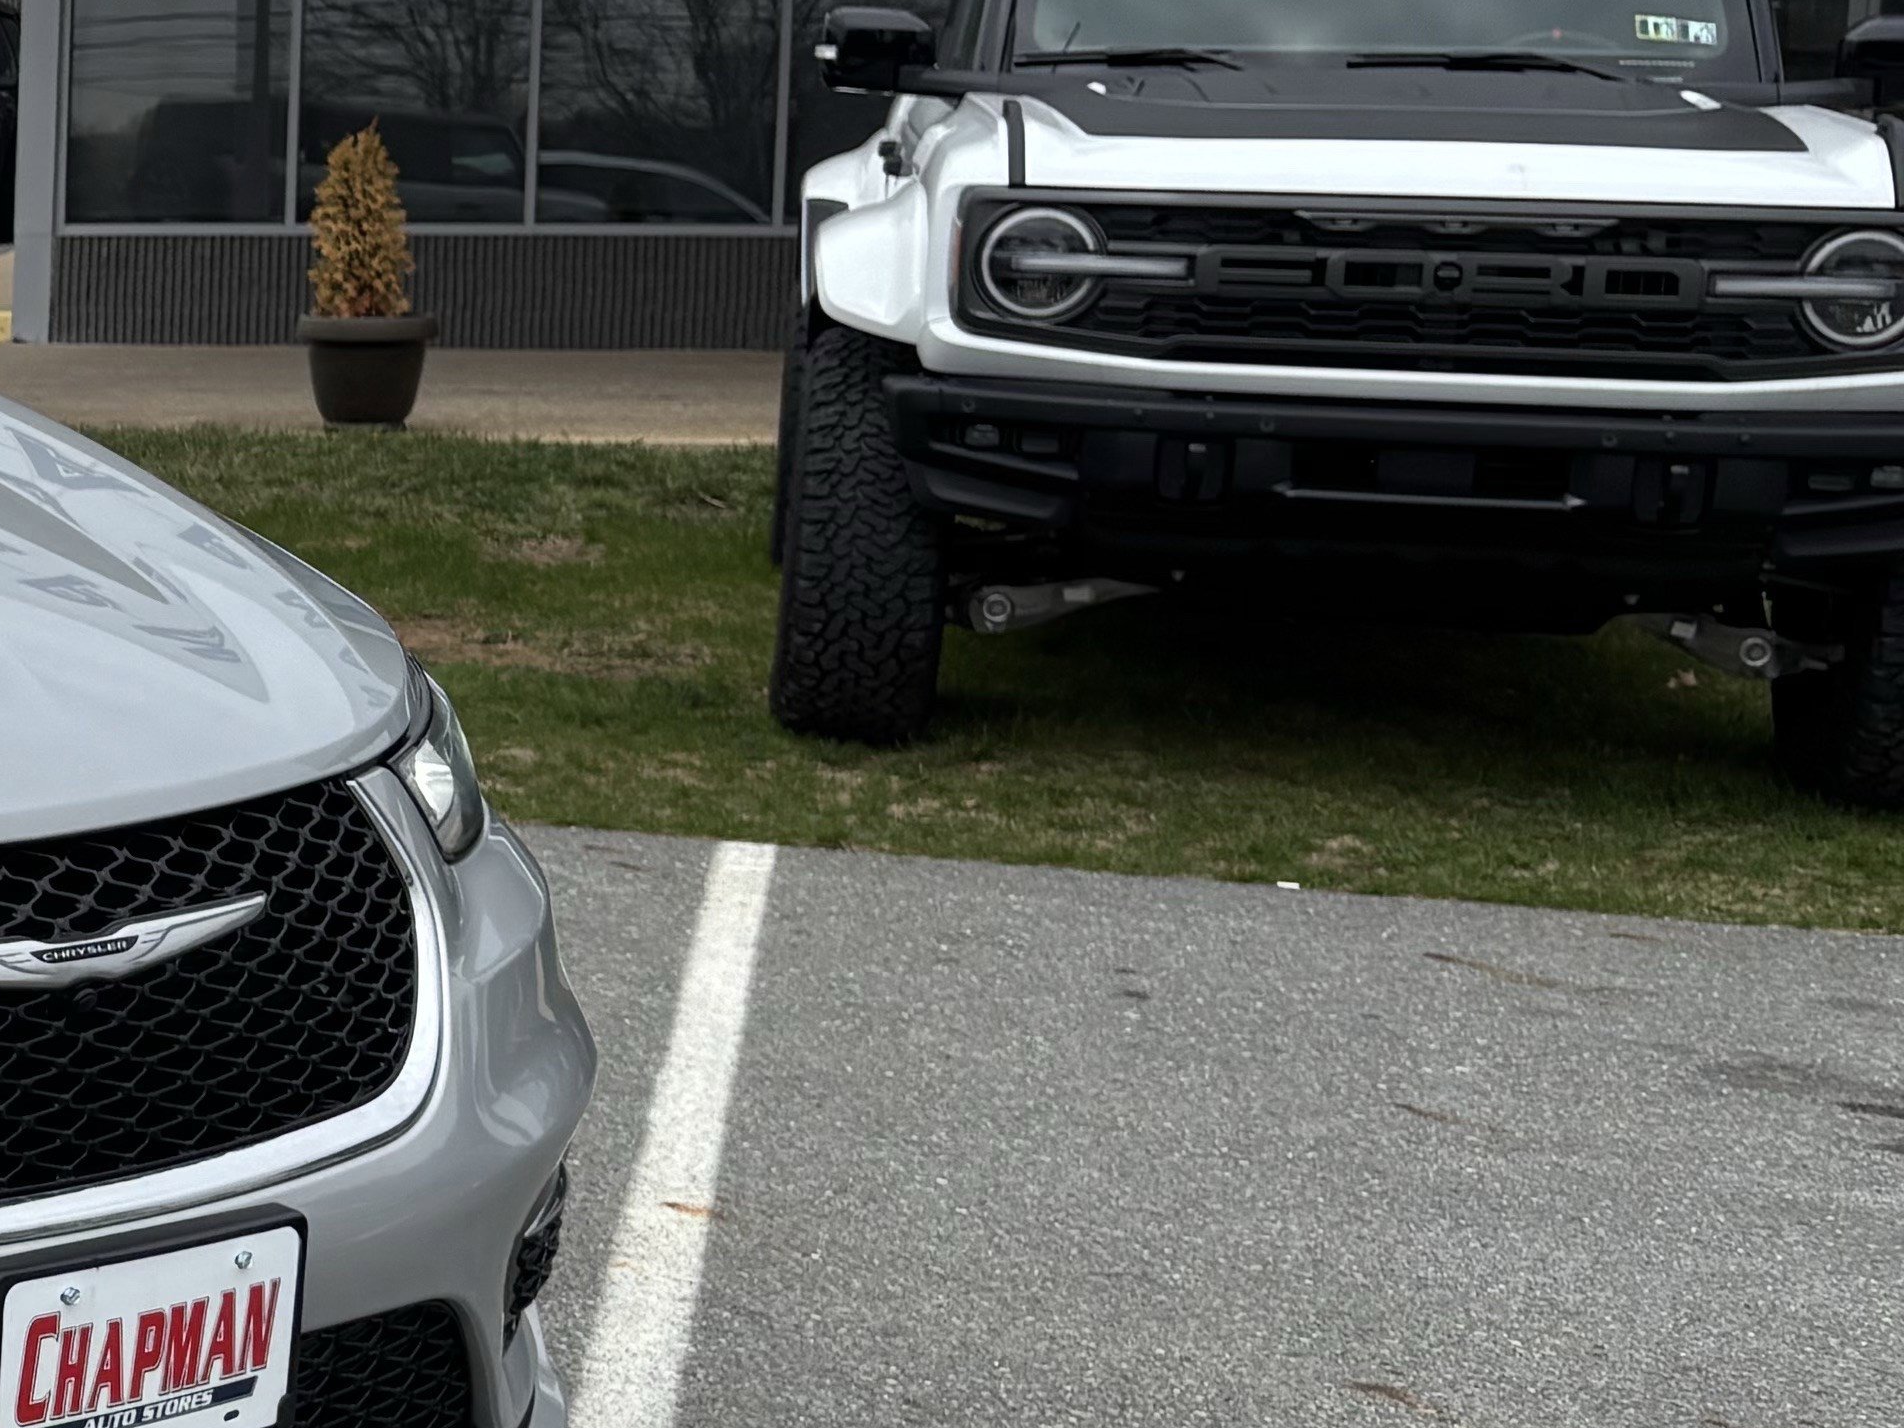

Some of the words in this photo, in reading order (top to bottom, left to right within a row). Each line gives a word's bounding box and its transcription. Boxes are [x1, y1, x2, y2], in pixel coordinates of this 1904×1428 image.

[41, 939, 128, 962] CHRYSLER
[13, 1276, 283, 1428] CHAPMAN
[141, 1388, 215, 1422] STORES
